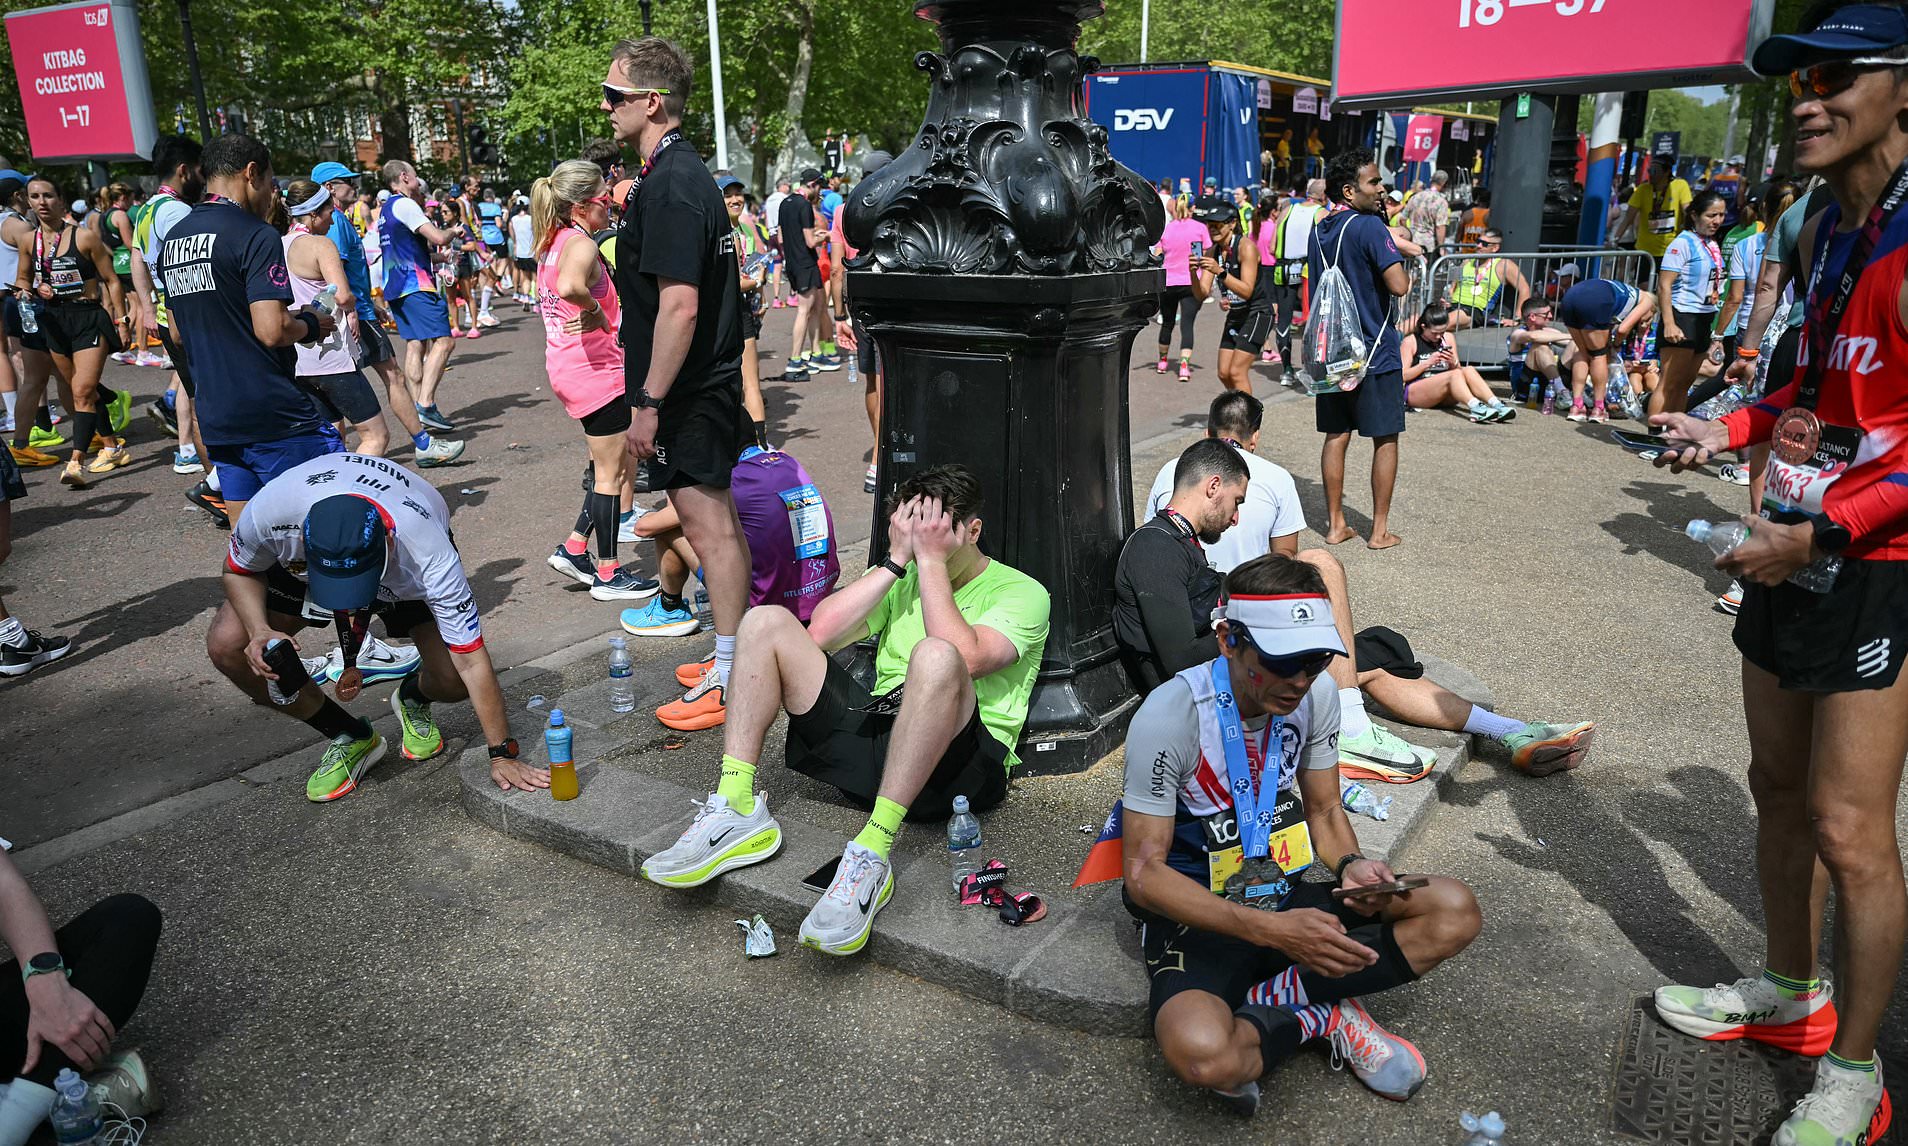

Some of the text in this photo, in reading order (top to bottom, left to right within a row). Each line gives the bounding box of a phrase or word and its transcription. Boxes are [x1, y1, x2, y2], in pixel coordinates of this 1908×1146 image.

[84, 11, 97, 25] tcs
[43, 48, 86, 70] KITBAG
[35, 71, 105, 95] COLLECTION
[1114, 108, 1175, 131] DSV
[1413, 135, 1433, 150] 18
[164, 235, 210, 266] MYRAA
[341, 455, 411, 488] MIGUEL
